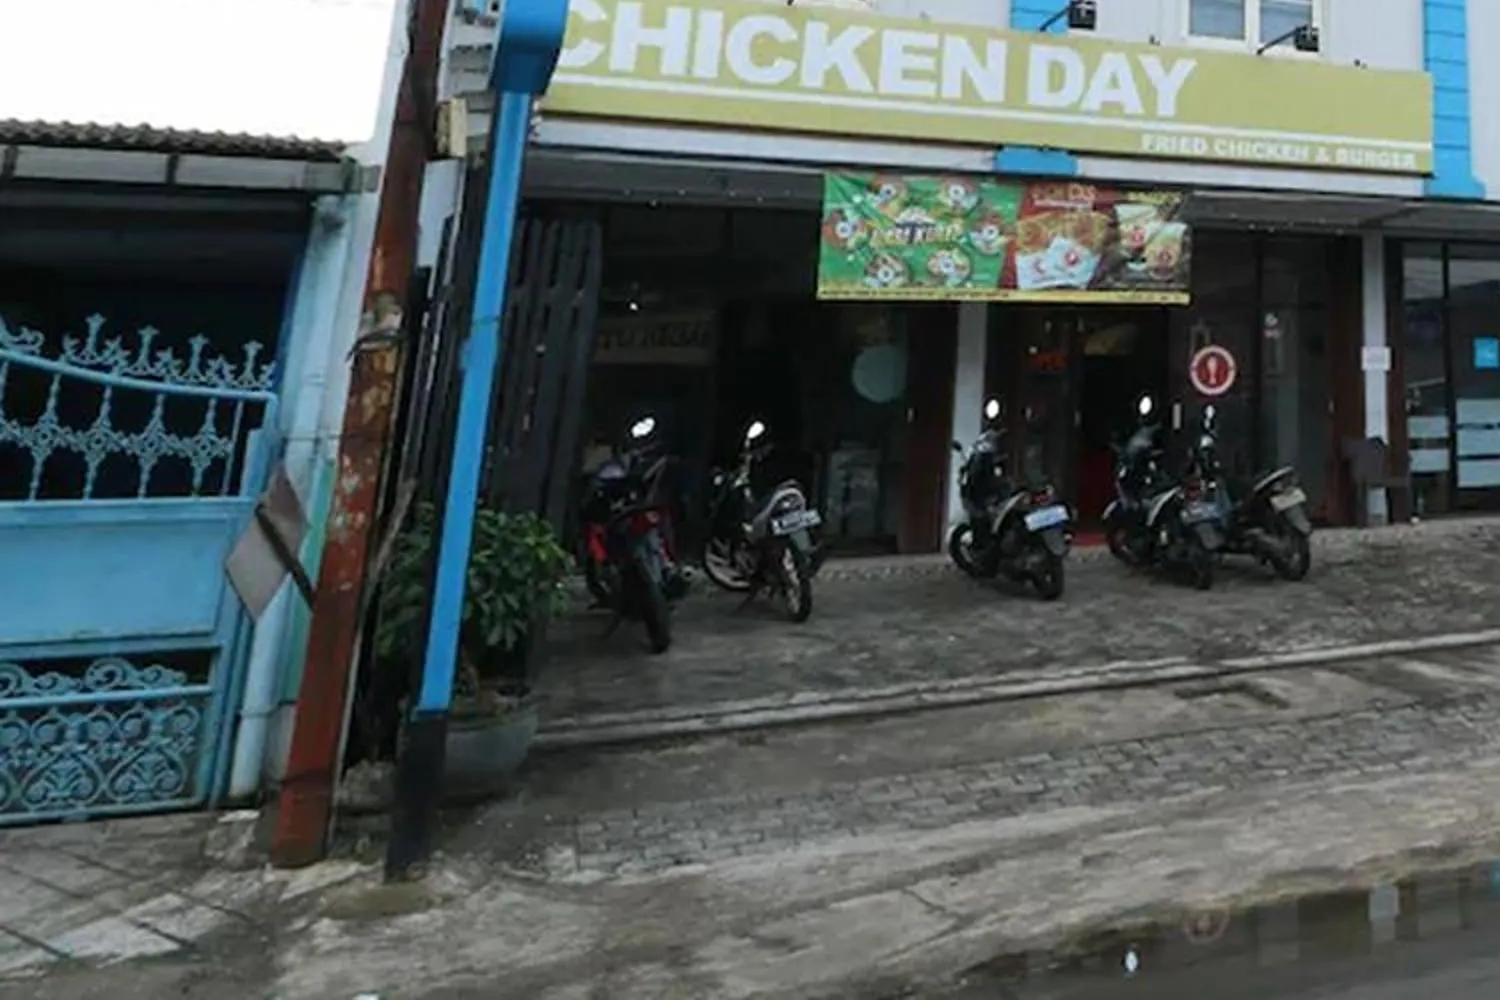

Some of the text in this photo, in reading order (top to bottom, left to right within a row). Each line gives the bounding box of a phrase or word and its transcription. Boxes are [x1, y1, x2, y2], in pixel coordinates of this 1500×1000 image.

[1026, 43, 1197, 117] DAY
[1141, 134, 1418, 170] FRIED CHICKEN & BURGER
